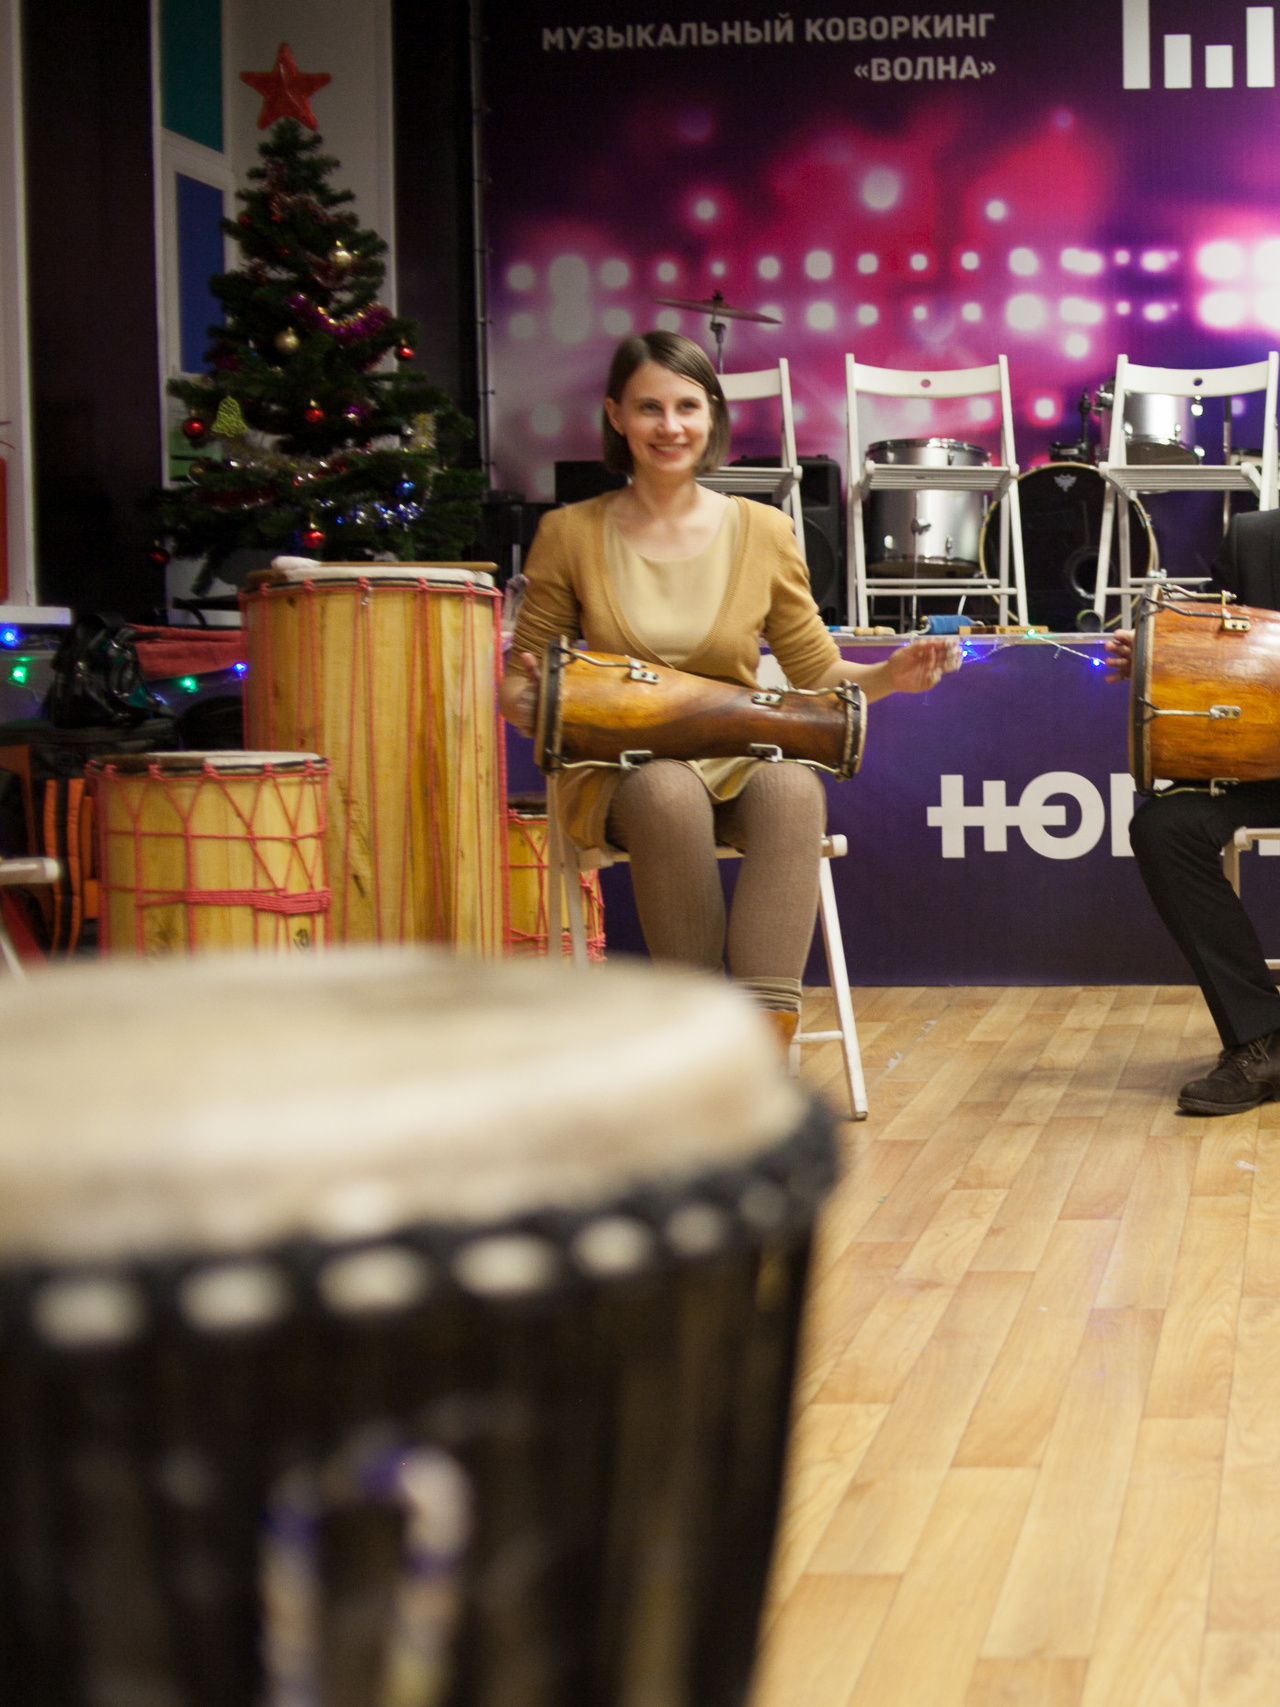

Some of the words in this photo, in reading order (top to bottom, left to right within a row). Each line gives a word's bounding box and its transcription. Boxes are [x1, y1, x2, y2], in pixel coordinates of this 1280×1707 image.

[542, 13, 794, 51] МУЗЫКАЛЬНЫЙ
[805, 13, 995, 42] КОВОРКИНГ
[854, 56, 996, 82] «ВОЛНА»
